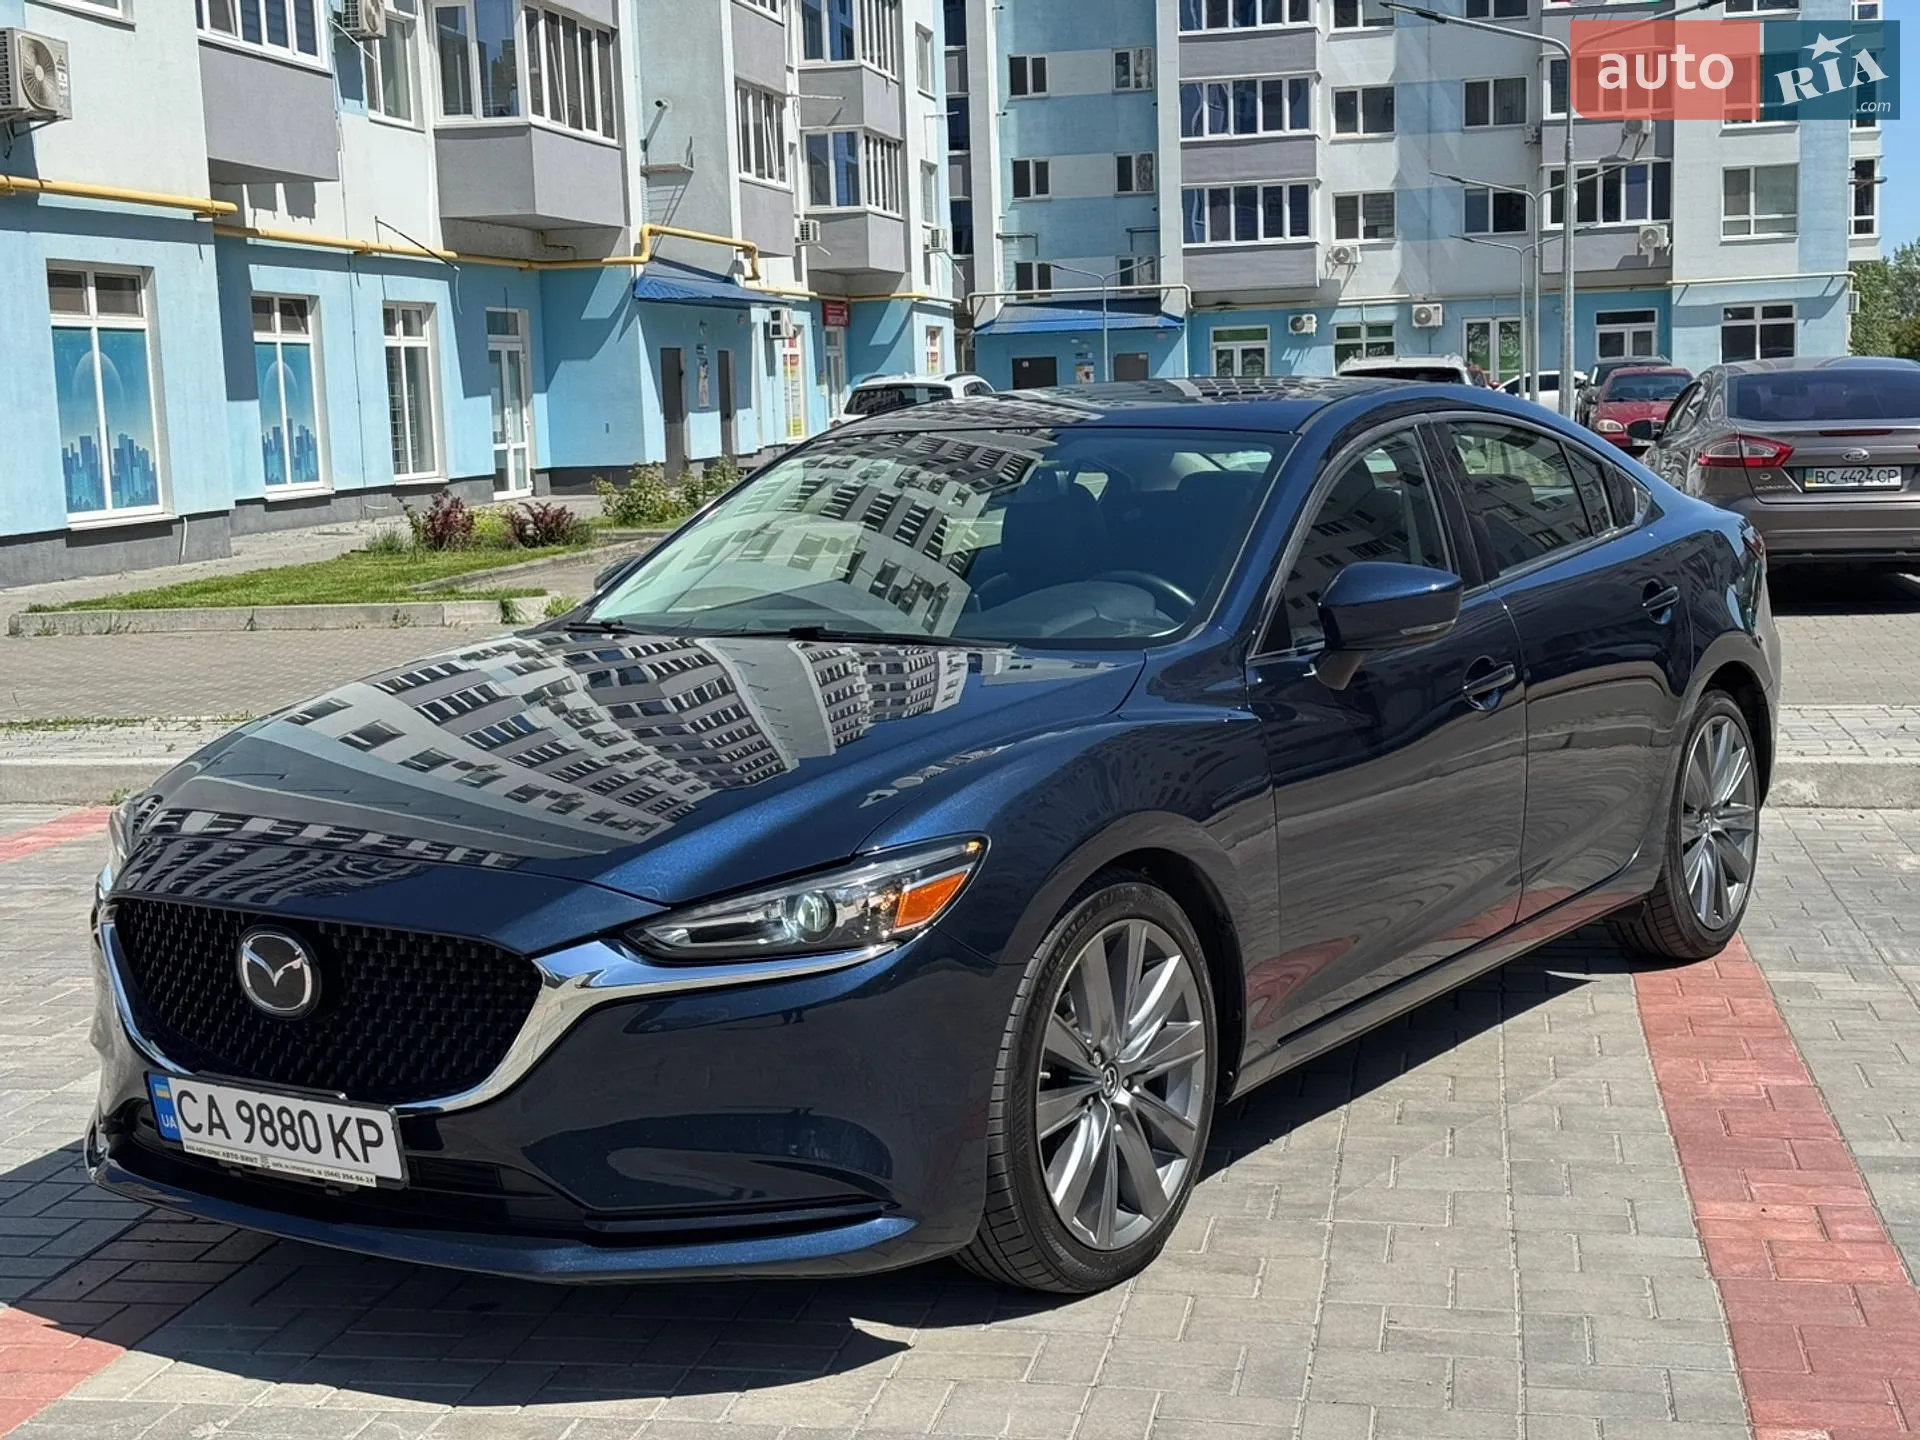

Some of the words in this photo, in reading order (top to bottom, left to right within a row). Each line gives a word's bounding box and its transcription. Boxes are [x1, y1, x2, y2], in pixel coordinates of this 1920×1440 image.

[1815, 470, 1837, 484] BC
[1840, 468, 1874, 484] 4424
[160, 1114, 178, 1128] UA
[177, 1090, 231, 1140] CA
[236, 1100, 322, 1155] 9880
[327, 1113, 384, 1163] KP
